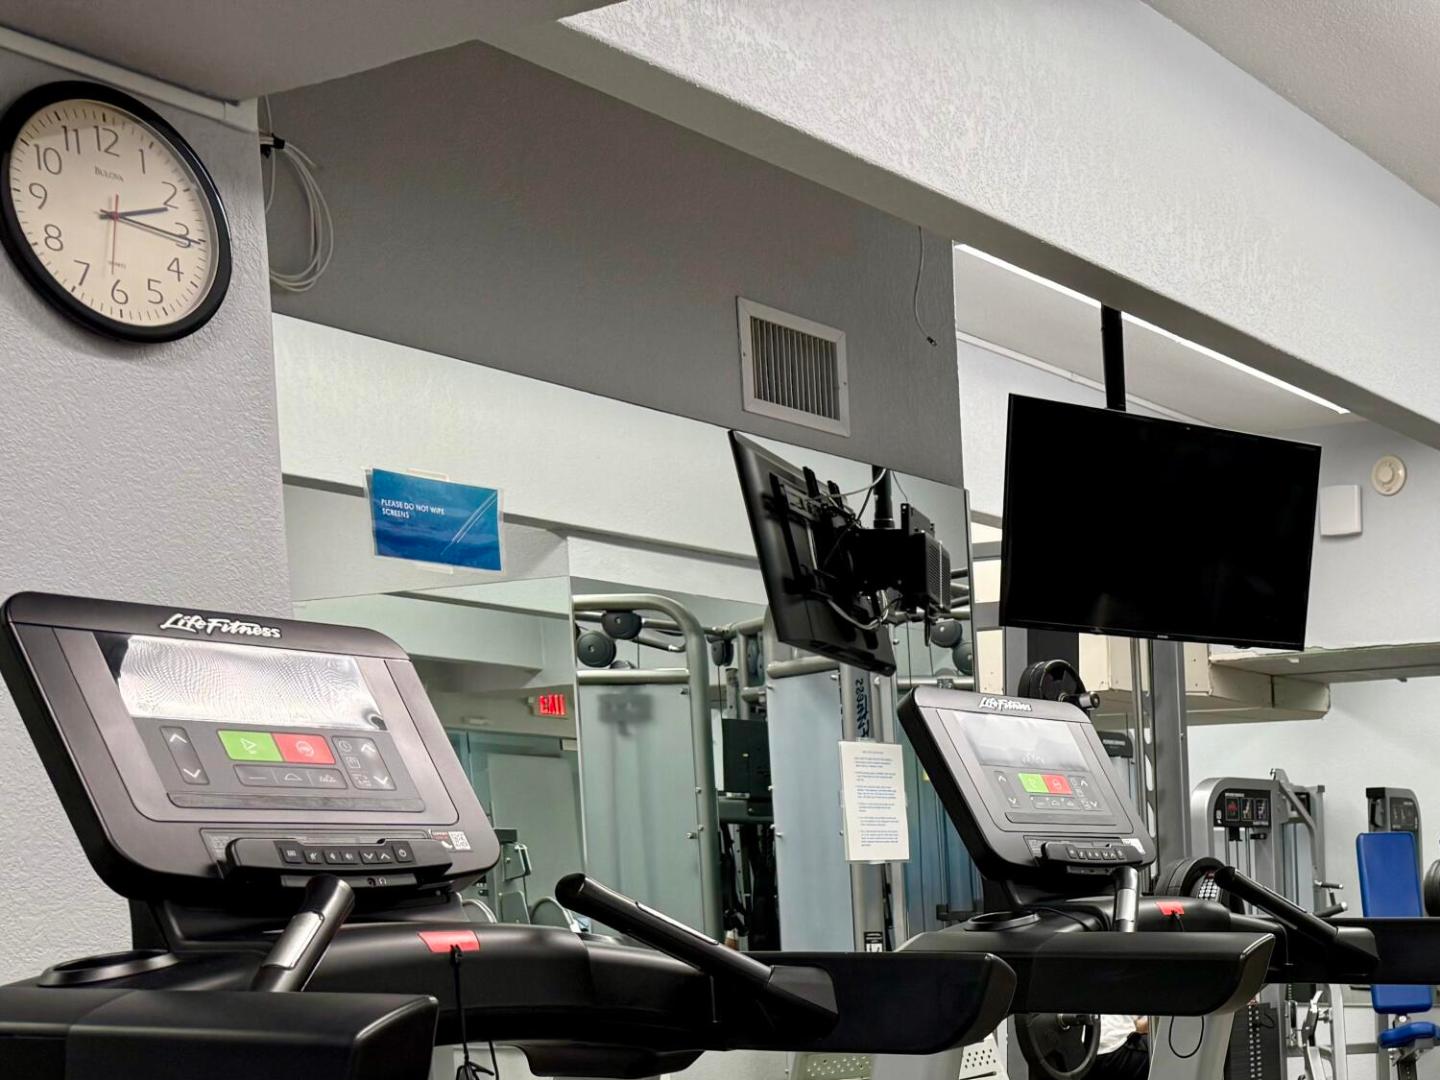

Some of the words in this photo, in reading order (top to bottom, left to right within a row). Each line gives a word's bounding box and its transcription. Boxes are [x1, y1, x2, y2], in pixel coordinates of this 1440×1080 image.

[61, 125, 81, 155] 11
[93, 125, 120, 157] 12
[34, 143, 62, 175] 10
[139, 149, 146, 175] 1
[28, 182, 48, 210] 9
[161, 181, 179, 209] 2
[44, 224, 64, 251] 8
[175, 222, 192, 249] 3
[73, 259, 90, 286] 7
[166, 257, 184, 282] 4
[110, 279, 129, 305] 6
[147, 278, 163, 304] 5
[381, 498, 403, 509] PLEASE
[404, 502, 415, 510] DO
[416, 504, 429, 513] NOT
[382, 508, 410, 519] SCREENS
